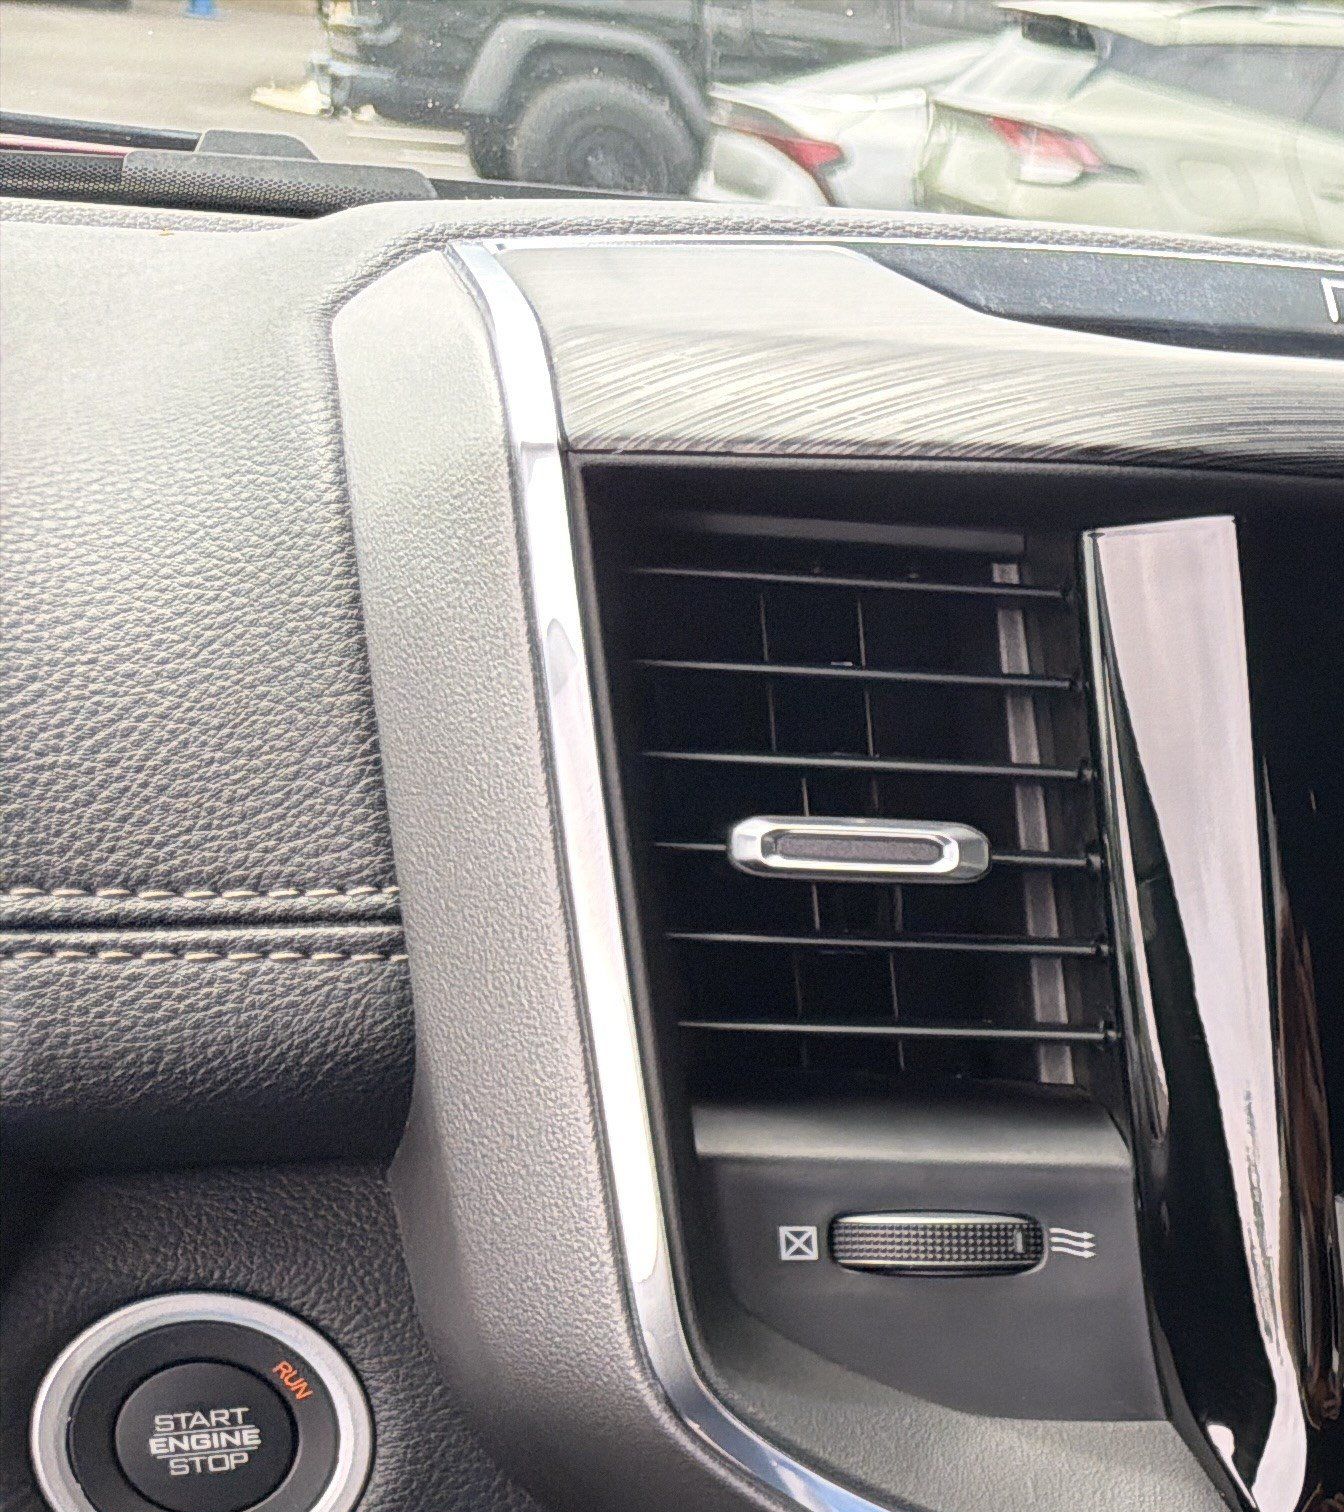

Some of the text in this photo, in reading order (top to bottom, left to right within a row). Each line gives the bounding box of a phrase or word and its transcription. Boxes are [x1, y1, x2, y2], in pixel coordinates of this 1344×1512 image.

[272, 1360, 314, 1401] RUN
[154, 1407, 251, 1433] START
[149, 1428, 262, 1455] ENGINE
[169, 1452, 249, 1476] STOP
